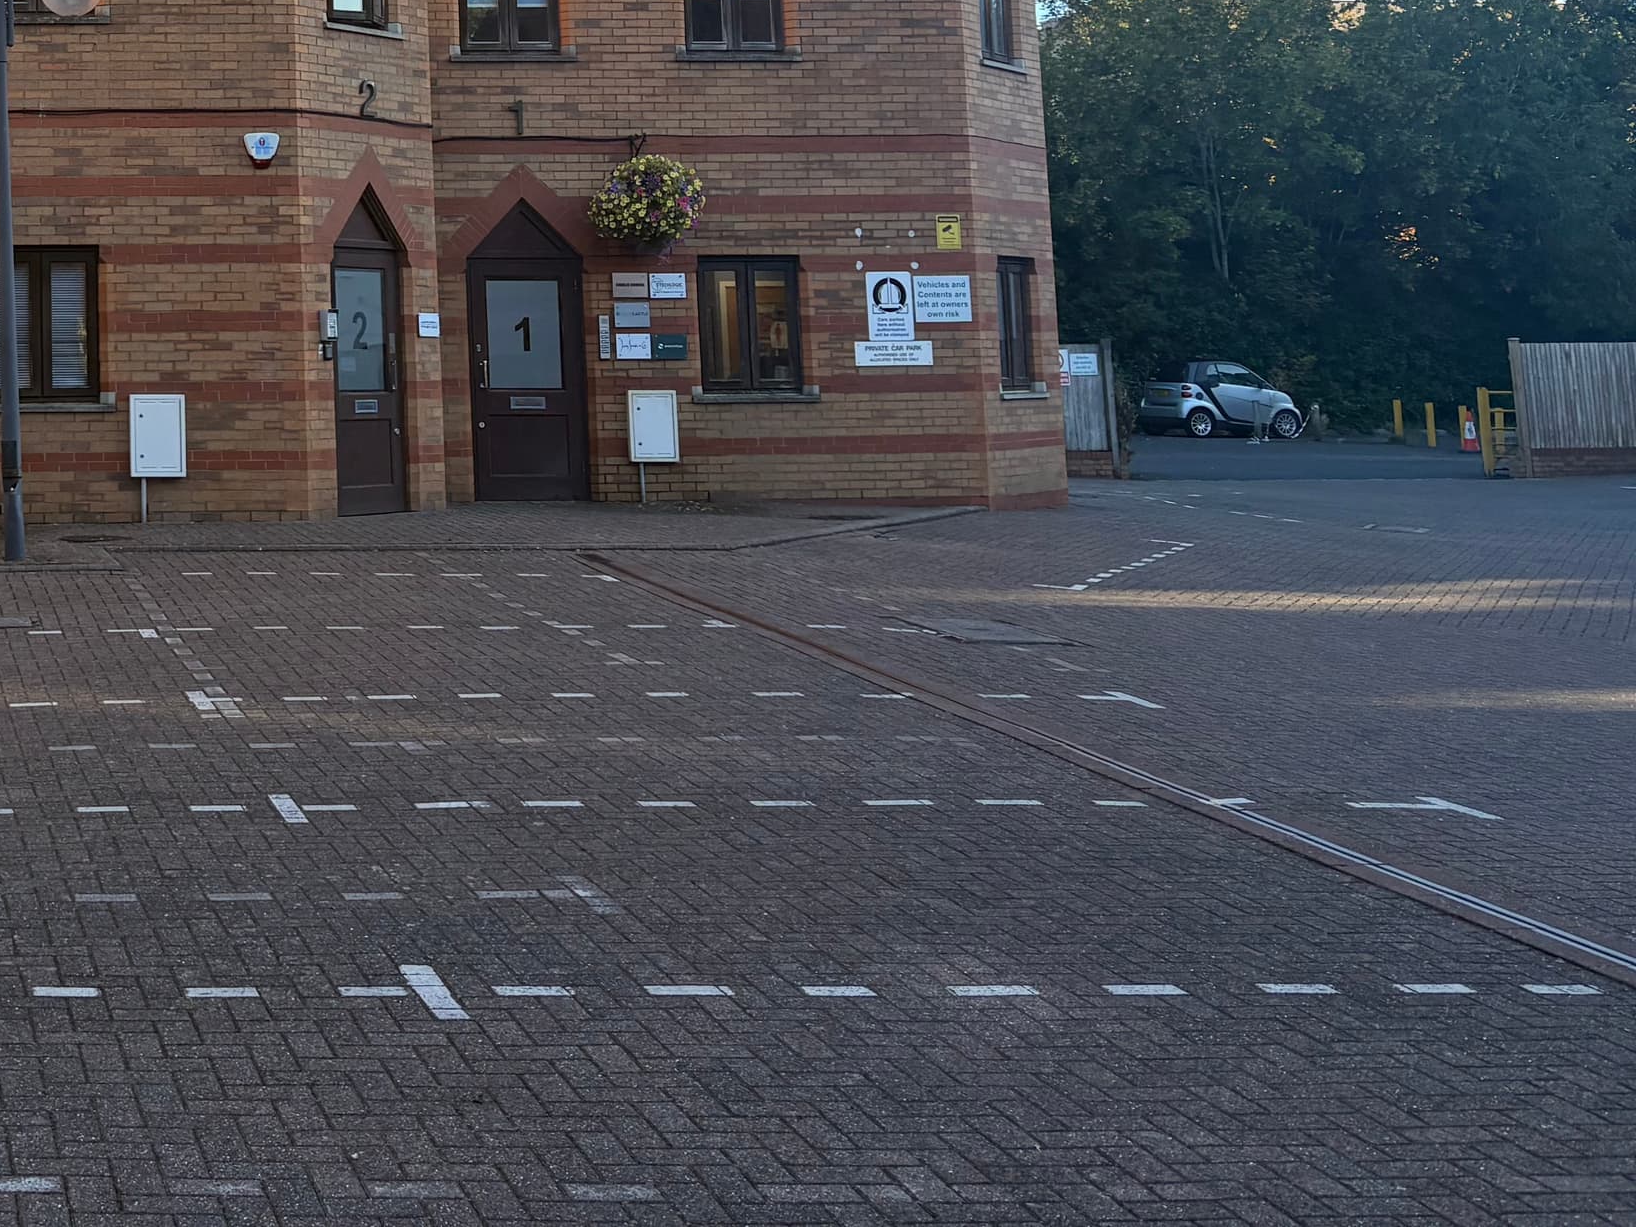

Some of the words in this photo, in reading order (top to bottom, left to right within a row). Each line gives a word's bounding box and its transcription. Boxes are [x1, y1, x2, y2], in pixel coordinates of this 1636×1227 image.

[358, 79, 378, 118] 2
[507, 99, 524, 135] 1
[352, 311, 368, 350] 2
[514, 317, 532, 352] 1
